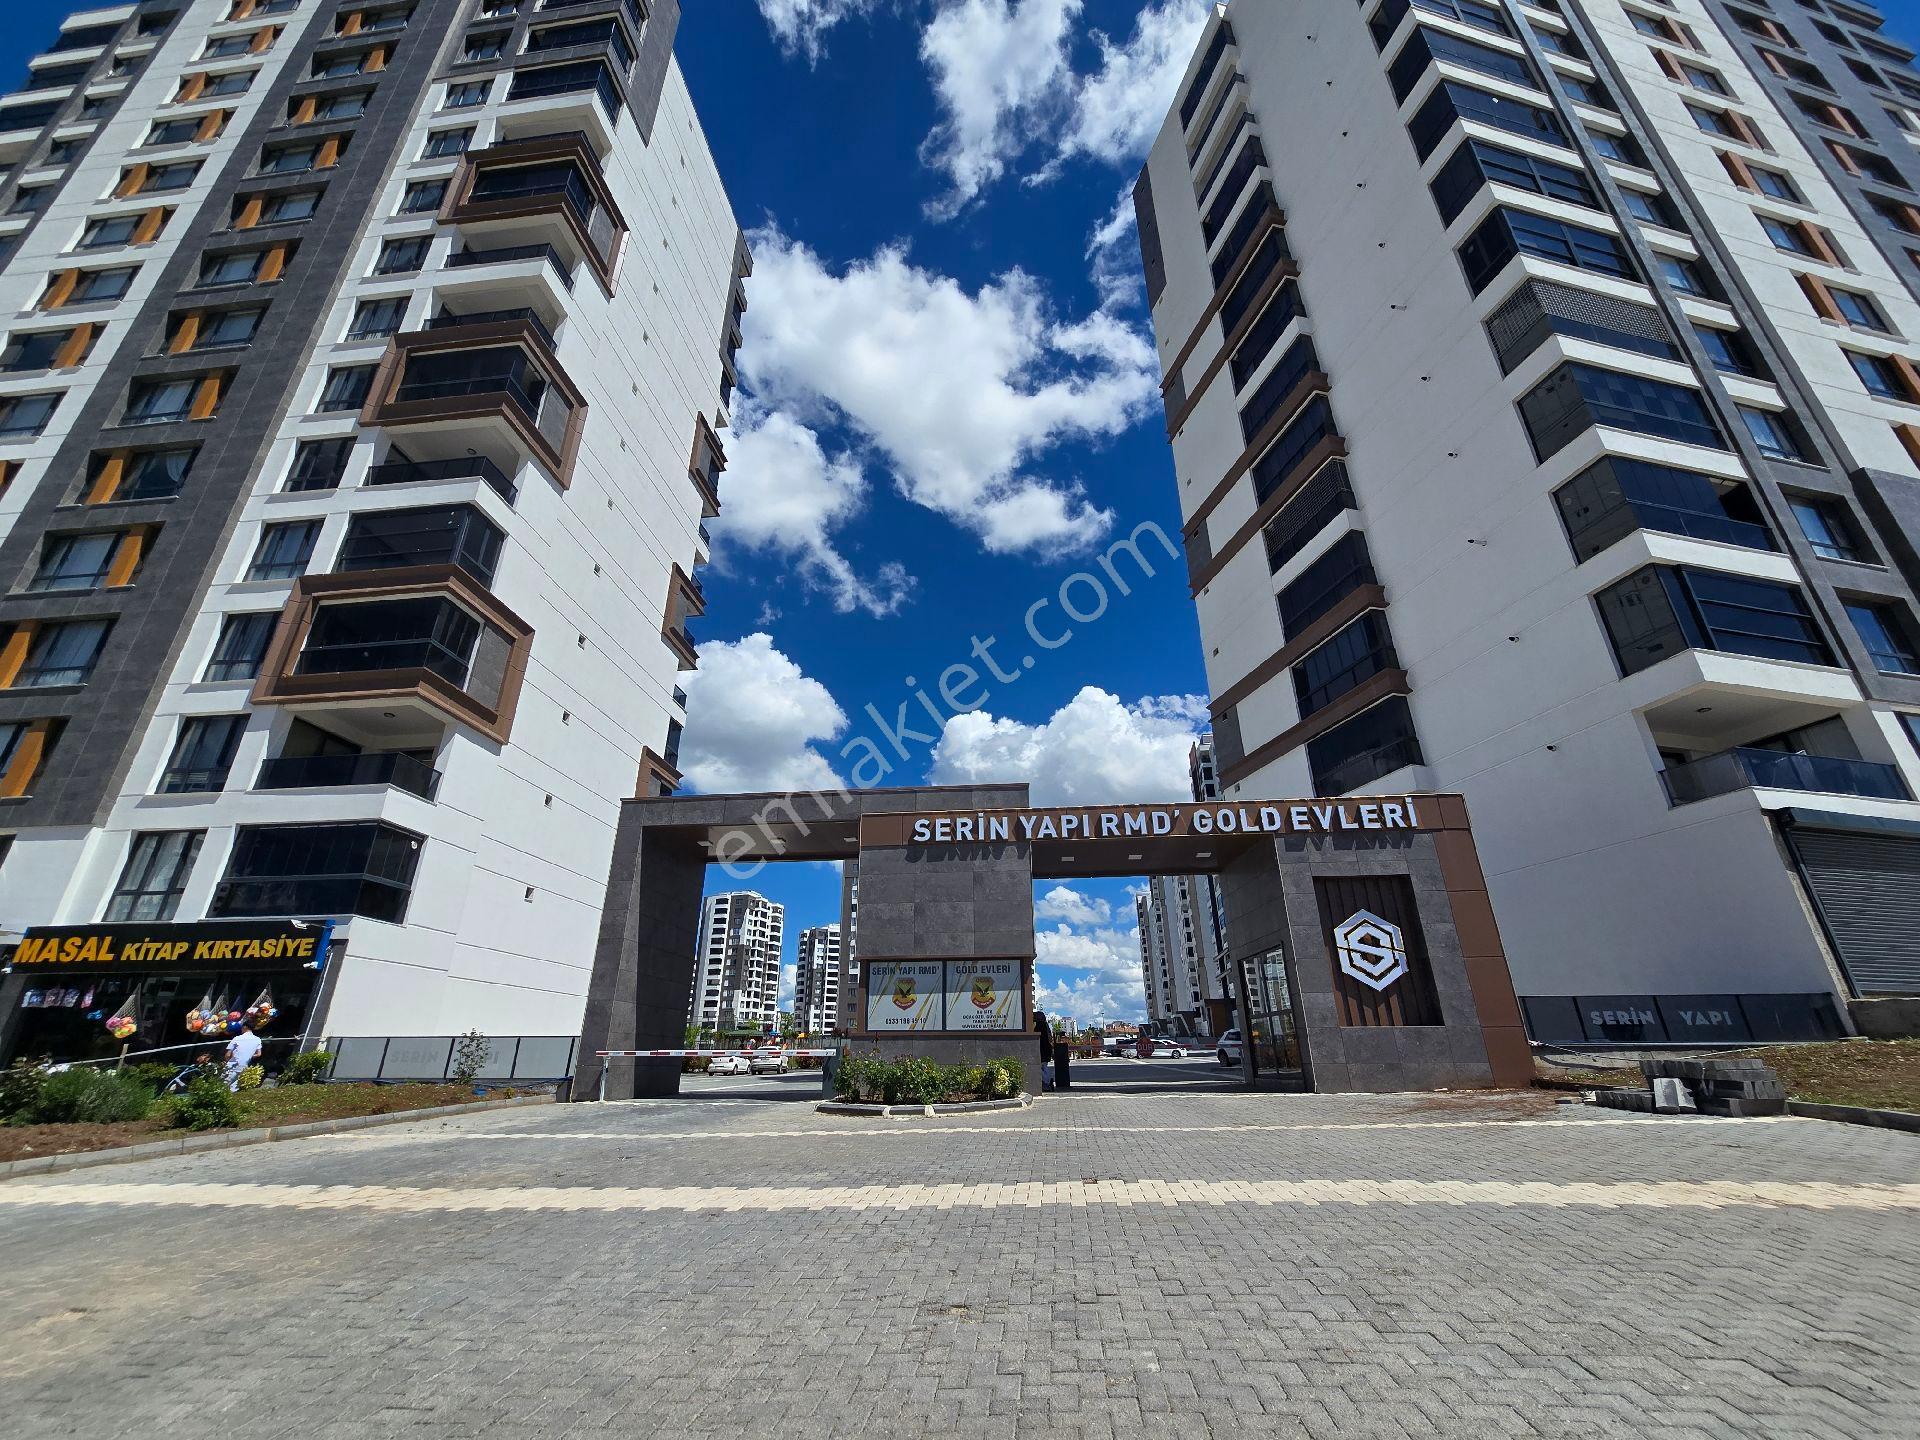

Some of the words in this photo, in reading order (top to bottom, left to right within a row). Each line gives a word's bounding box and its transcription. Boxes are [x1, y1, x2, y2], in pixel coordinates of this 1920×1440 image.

[913, 812, 1008, 842] SERİN
[1019, 814, 1090, 839] YAPI
[1193, 806, 1281, 834] GOLD
[1290, 797, 1418, 830] EVLERİ
[12, 936, 114, 963] MASAL
[120, 937, 190, 961] KİTAP
[193, 934, 315, 960] KIRTASİYE
[956, 965, 978, 974] GOLD
[981, 963, 1011, 974] EVLERİ
[1590, 1007, 1656, 1025] SERİN
[1678, 1010, 1733, 1026] YAPI
